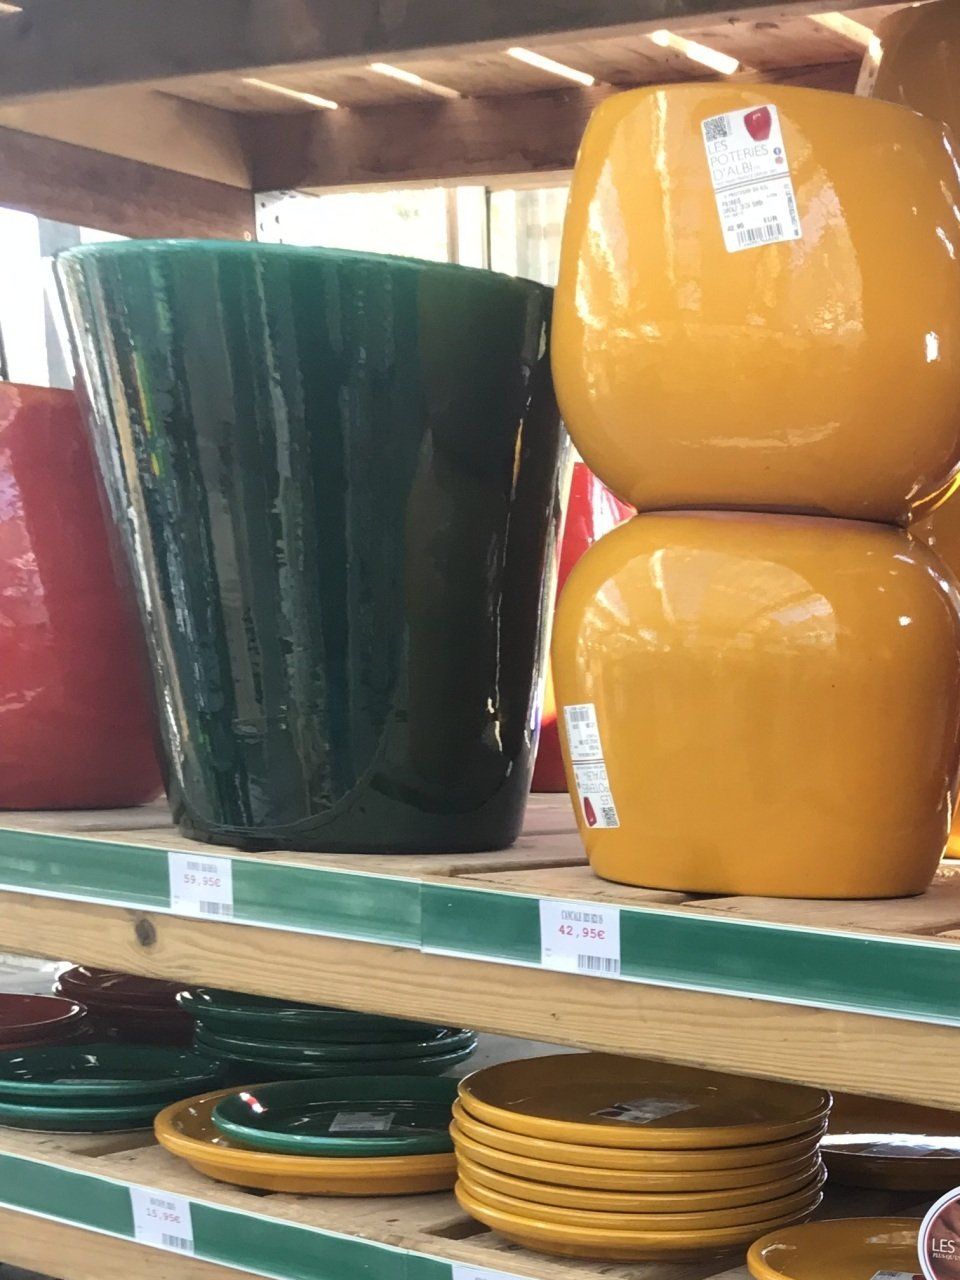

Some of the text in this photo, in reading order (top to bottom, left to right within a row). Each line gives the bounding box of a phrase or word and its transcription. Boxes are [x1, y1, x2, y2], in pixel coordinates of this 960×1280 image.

[707, 139, 729, 155] LES
[710, 144, 769, 168] POTERIES
[558, 924, 606, 940] 42,95€
[931, 1238, 955, 1254] LES
